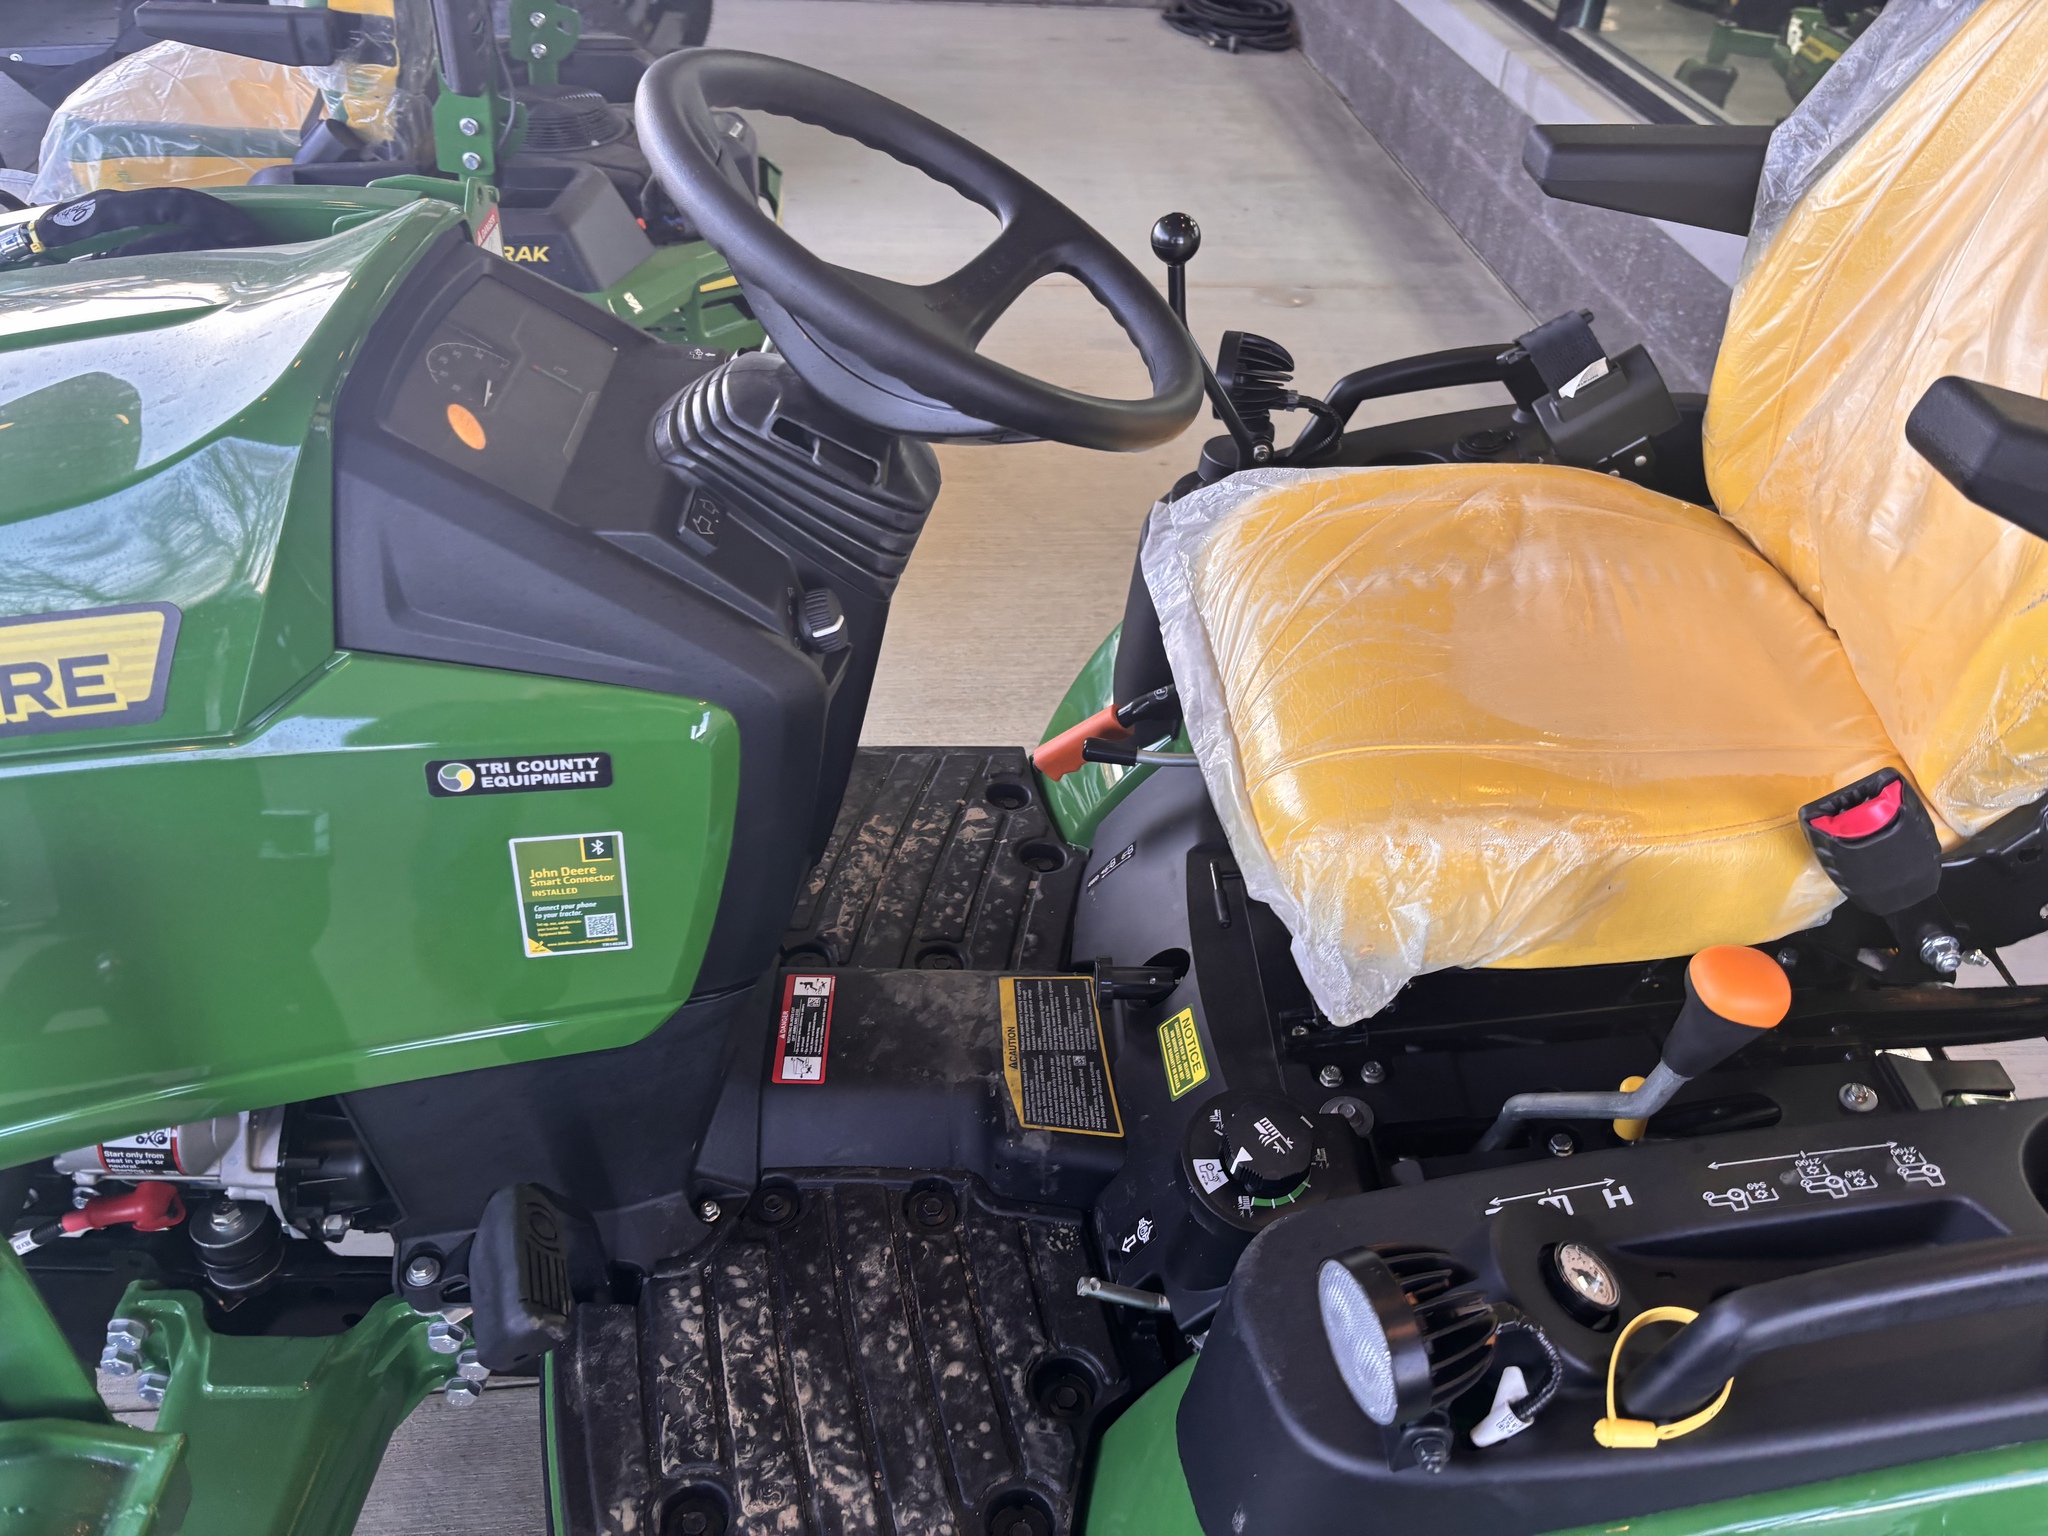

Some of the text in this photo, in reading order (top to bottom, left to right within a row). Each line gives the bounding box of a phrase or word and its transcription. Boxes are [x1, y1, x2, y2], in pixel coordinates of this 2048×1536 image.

[476, 757, 600, 775] TRI COUNTY
[481, 771, 599, 788] EQUIPMENT
[529, 867, 597, 878] John Deere
[530, 874, 615, 887] Smart Connector
[532, 888, 578, 897] INSTALLED
[780, 1011, 788, 1032] DANGER
[1007, 1026, 1018, 1061] CAUTION
[1182, 1017, 1202, 1073] NOTICE
[1602, 1185, 1634, 1208] H
